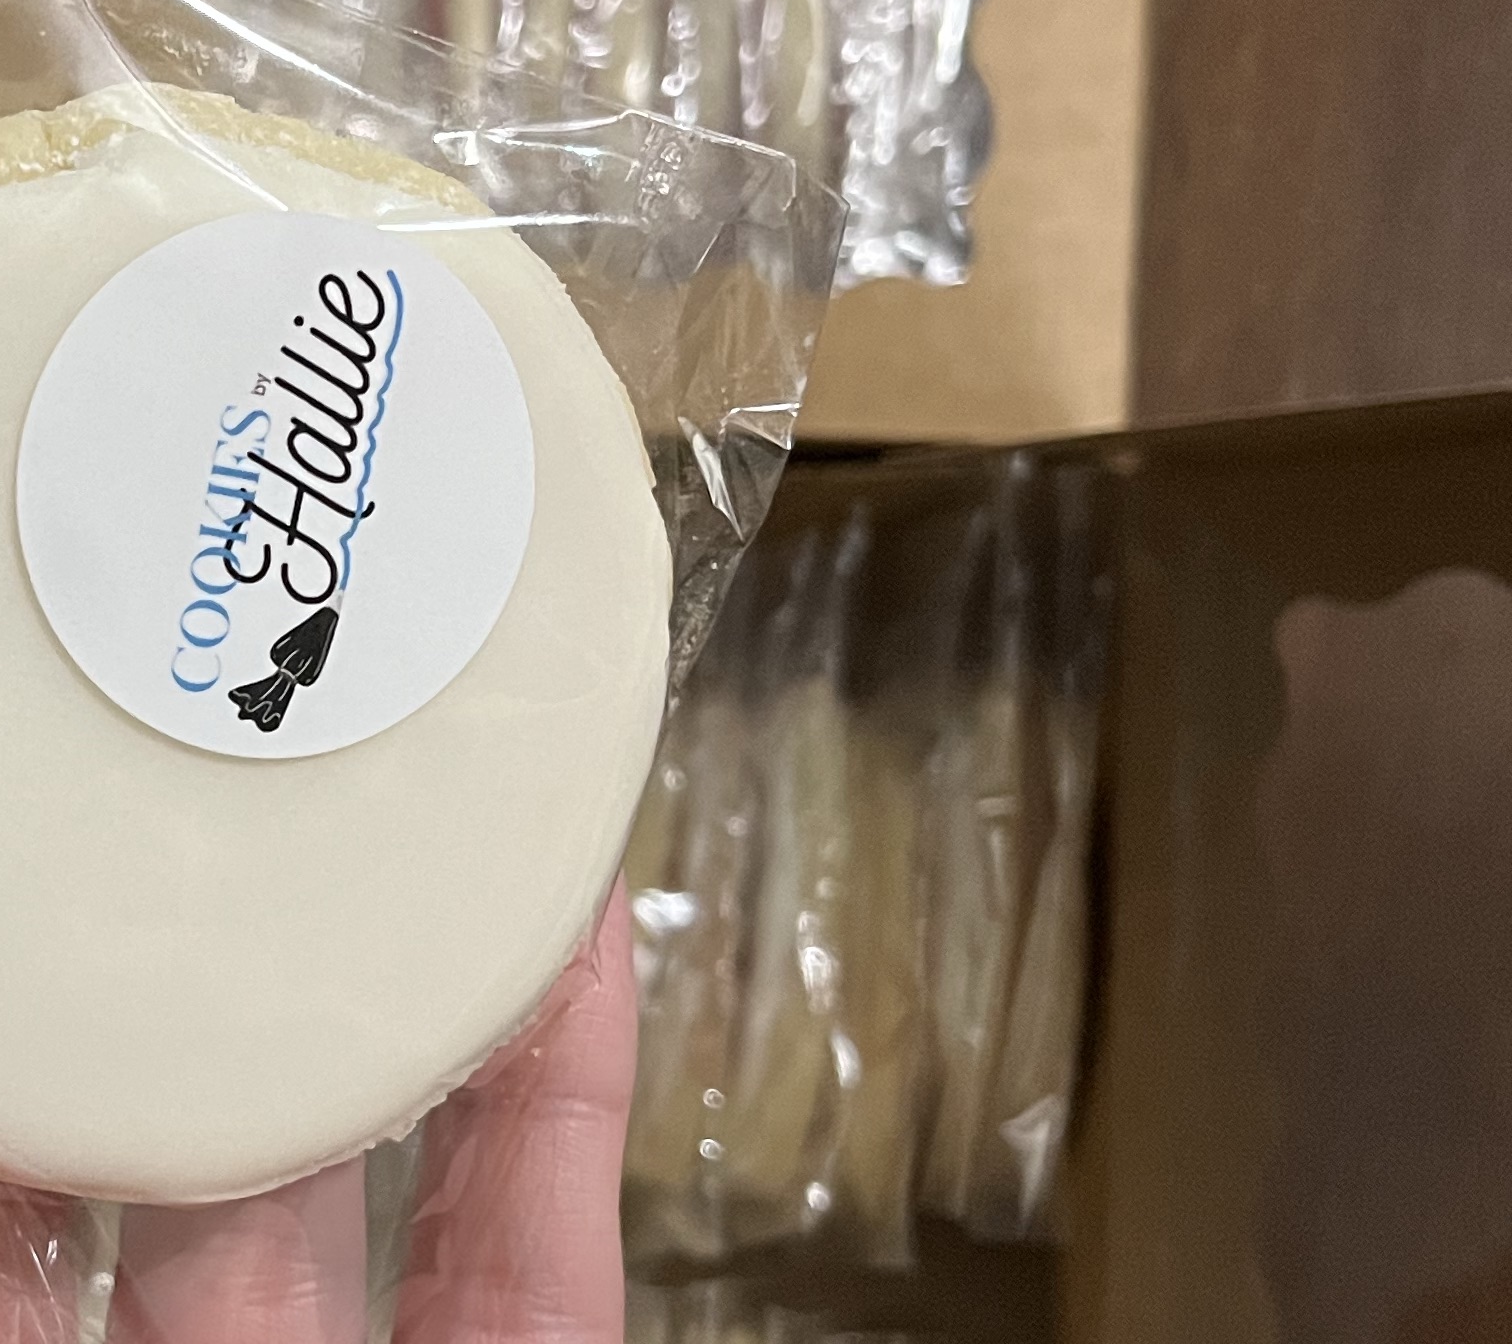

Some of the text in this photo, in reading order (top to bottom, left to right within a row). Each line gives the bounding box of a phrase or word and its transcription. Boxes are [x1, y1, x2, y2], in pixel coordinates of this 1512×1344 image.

[171, 371, 273, 692] COOKIES by
[223, 269, 385, 604] Hallie
